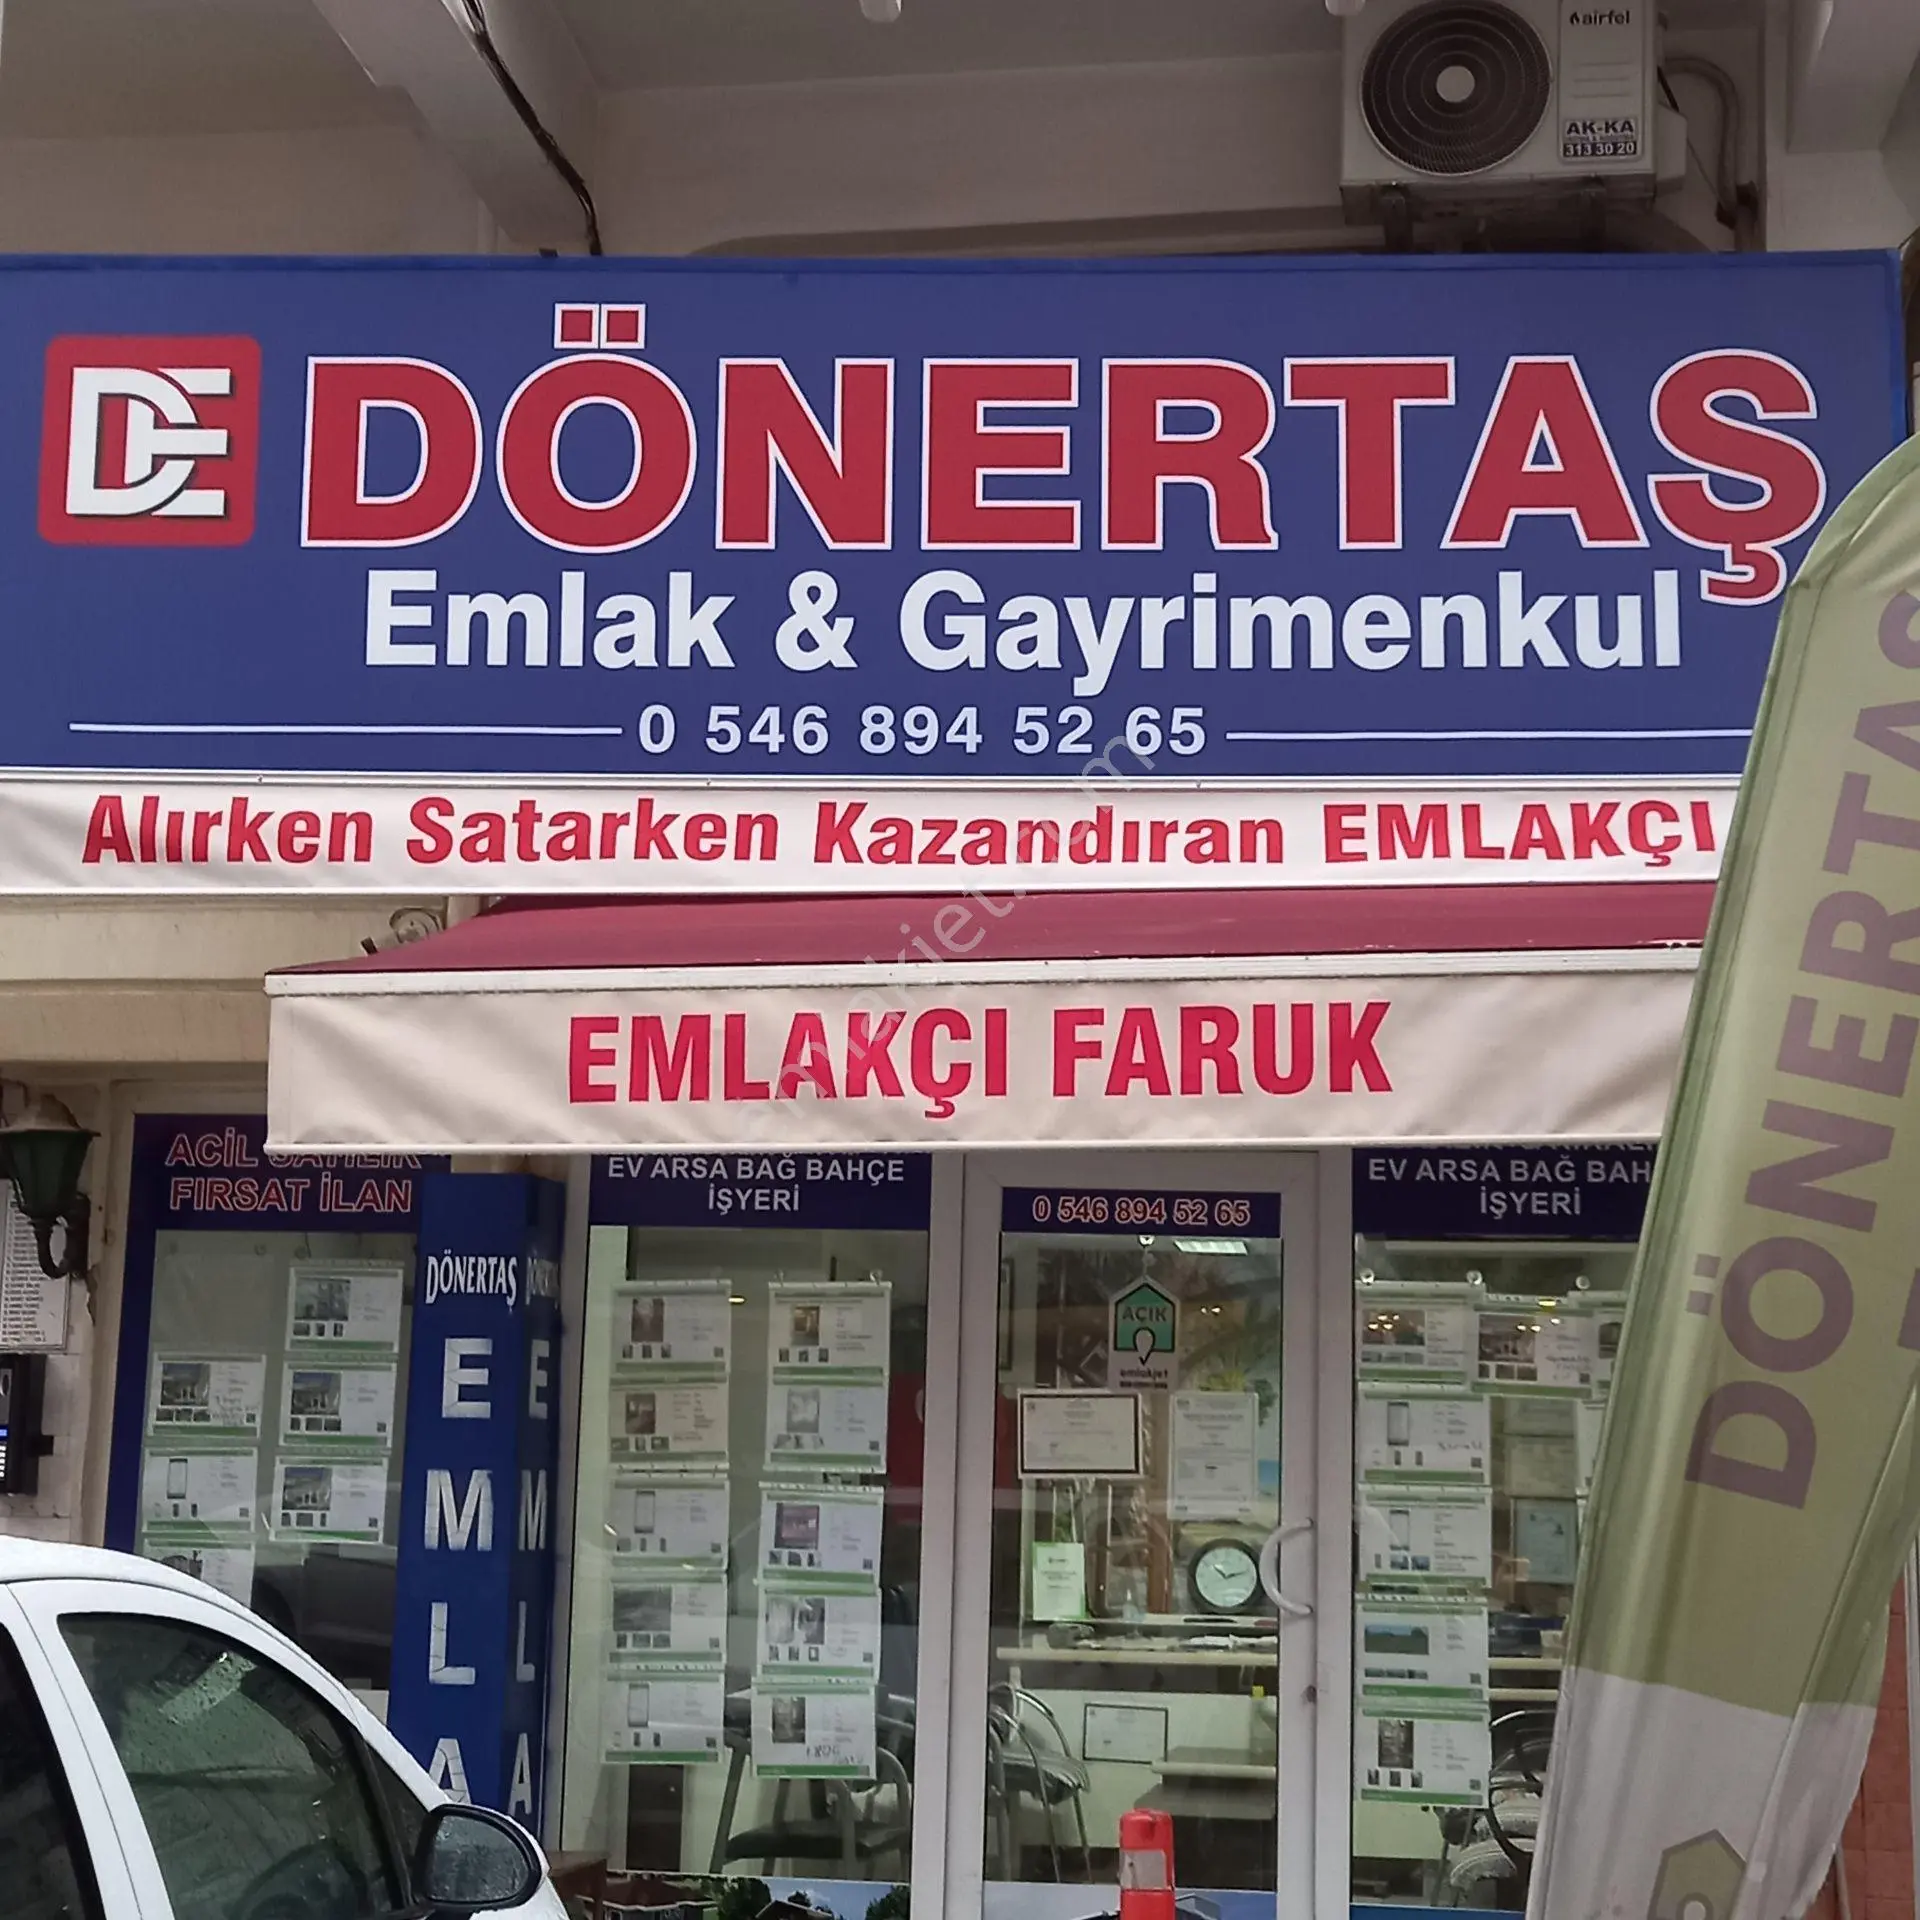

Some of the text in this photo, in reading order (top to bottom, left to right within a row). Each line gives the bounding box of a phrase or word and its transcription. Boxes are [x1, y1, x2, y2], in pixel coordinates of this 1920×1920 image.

[1582, 10, 1630, 25] airfel
[1566, 119, 1635, 135] AK-KA
[1565, 142, 1635, 156] 313 30 20
[300, 302, 1828, 607] DÖNERTAŞ
[365, 569, 1681, 697] Emlak & Gayrimenkul
[638, 704, 1207, 756] 0 546 894 52 65
[82, 794, 1717, 868] Alırken Satarken Kazandıran EMLAKÇI
[569, 1001, 1395, 1119] EMLAKÇI FARUK
[1684, 589, 1920, 1510] DÖNERTA
[165, 1127, 259, 1168] ACİL
[608, 1152, 905, 1187] EV ARSA BAĞ BAHÇE
[1368, 1153, 1652, 1184] EV ARSA BAĞ BAH
[170, 1171, 412, 1213] FIRSAT İLAN
[708, 1183, 800, 1217] İŞYERİ
[1033, 1195, 1252, 1227] 0 546 894 52 65
[1480, 1186, 1582, 1220] İŞYERİ
[425, 1248, 518, 1315] DÖNERTAŞ
